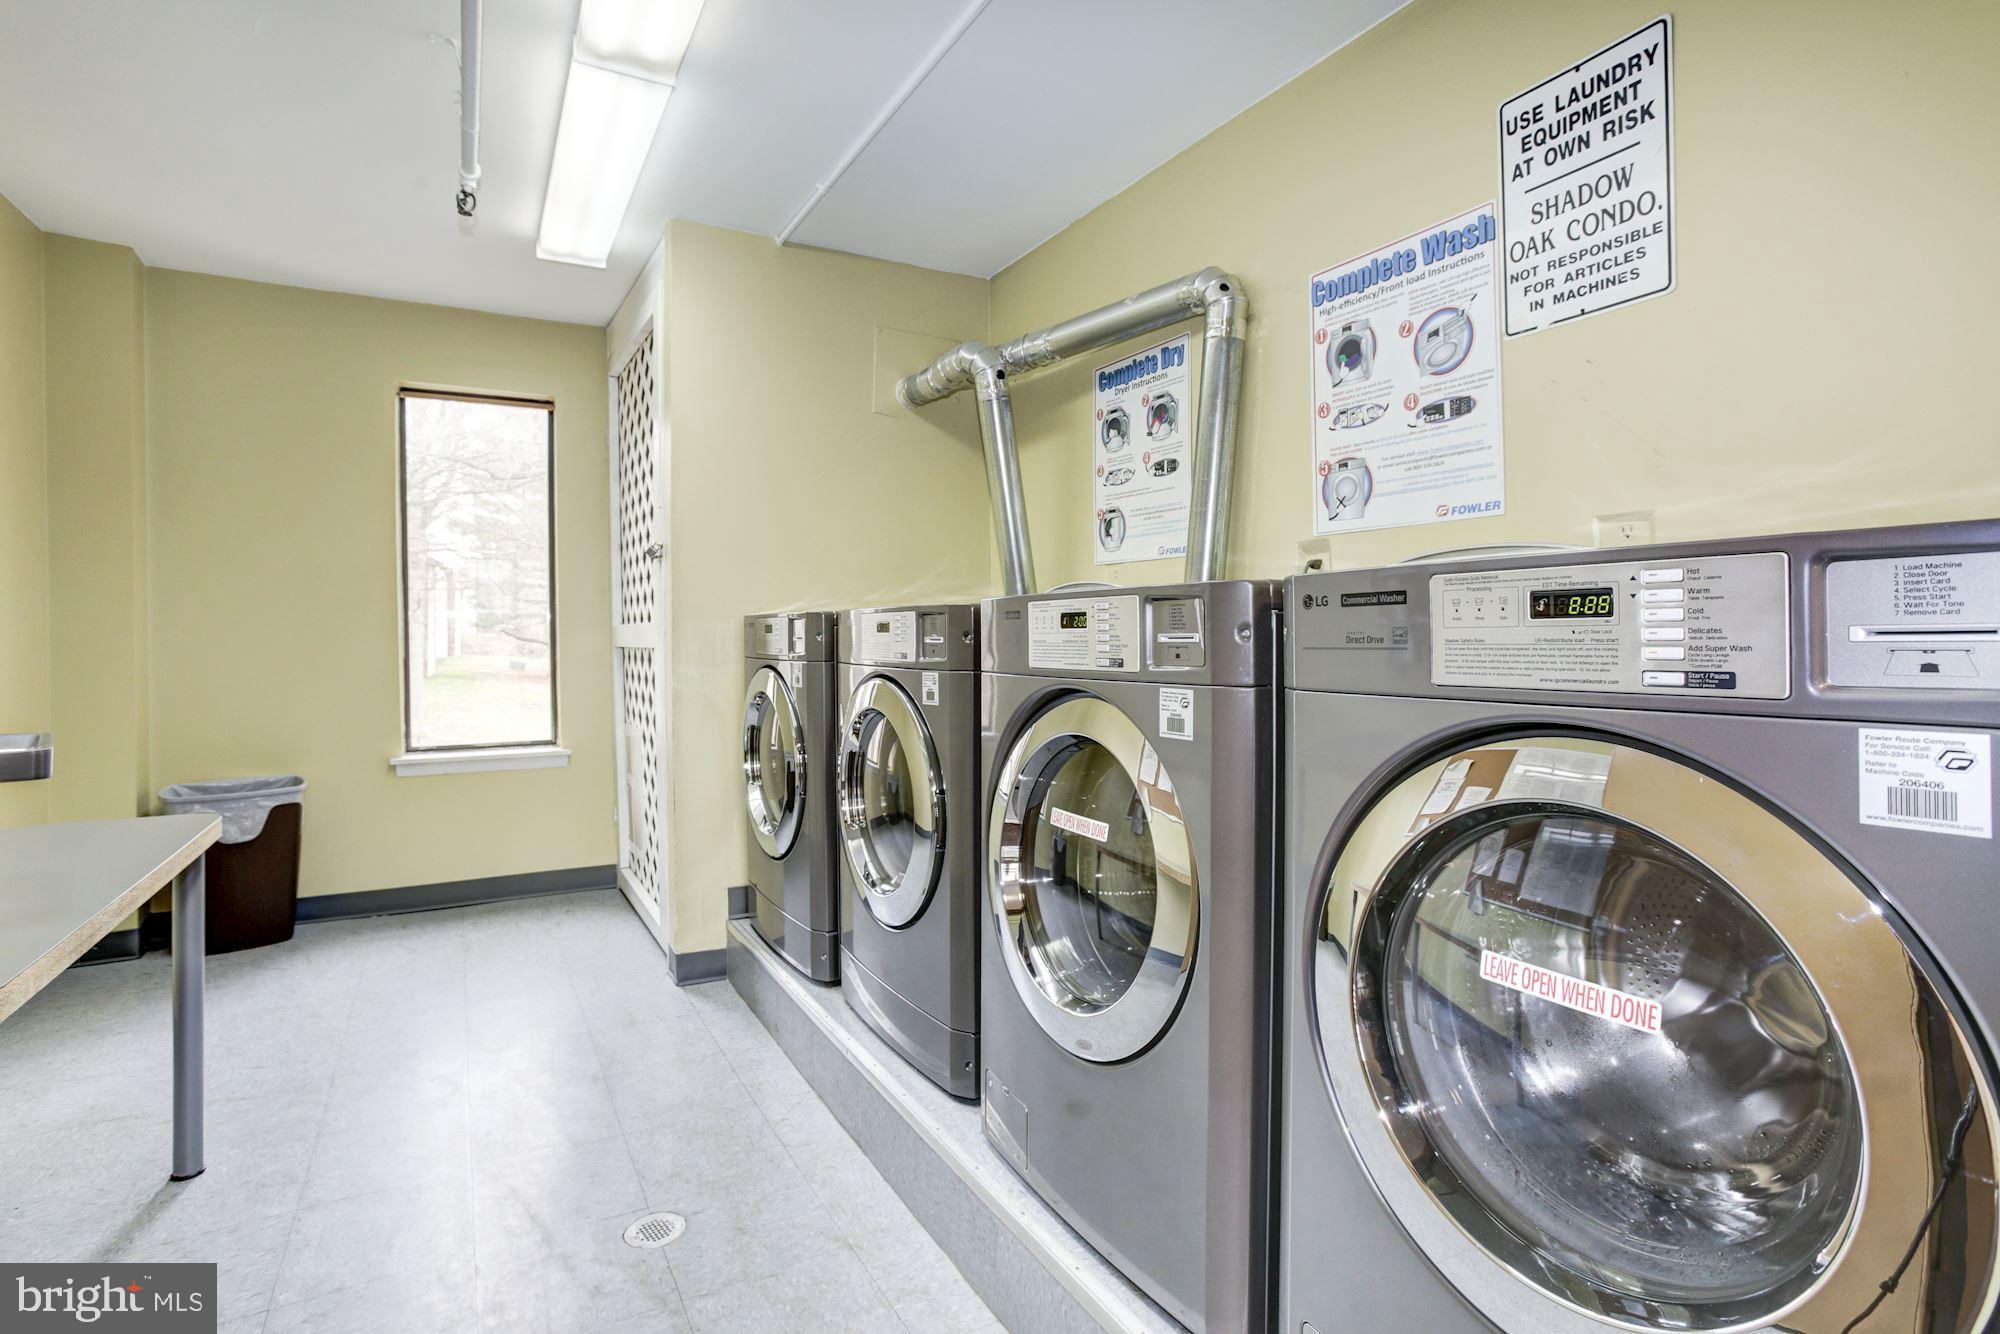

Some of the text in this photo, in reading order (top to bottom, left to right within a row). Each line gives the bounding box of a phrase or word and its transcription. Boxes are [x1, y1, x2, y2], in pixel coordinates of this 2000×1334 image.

[1506, 43, 1660, 136] USE LAUNDRY
[1521, 80, 1642, 154] EQUIPMENT
[1512, 100, 1656, 182] AT OWN RISK
[1530, 163, 1635, 224] SHADOW
[1510, 191, 1663, 263] OAK CONDO.
[1312, 248, 1416, 307] Complete
[1421, 214, 1496, 265] Wash
[1407, 272, 1426, 284] load
[1429, 251, 1485, 277] Instructions
[1510, 221, 1663, 284] NOT RESPONSIBLE
[1524, 278, 1554, 297] FOR
[1564, 247, 1646, 284] ARTICLES
[1530, 268, 1640, 312] IN MACHINES
[1099, 355, 1158, 392] Complete
[1160, 344, 1184, 369] Dry
[1115, 385, 1130, 396] Dryer
[1132, 372, 1168, 390] Instructions
[1451, 500, 1501, 516] FOWLER
[1166, 546, 1186, 555] FOWLE
[1316, 596, 1328, 606] LG
[1343, 594, 1405, 604] Commercial Washer
[1923, 738, 1966, 747] Company
[1865, 768, 1899, 776] Machine
[1899, 779, 1944, 789] 206406
[1064, 814, 1075, 830] OPEN
[1076, 817, 1091, 834] WHEN
[1091, 822, 1107, 839] DONE
[1867, 814, 1983, 832] www.fowlercompanies.com
[1484, 954, 1658, 1030] LEAVE OPEN WHEN DONE
